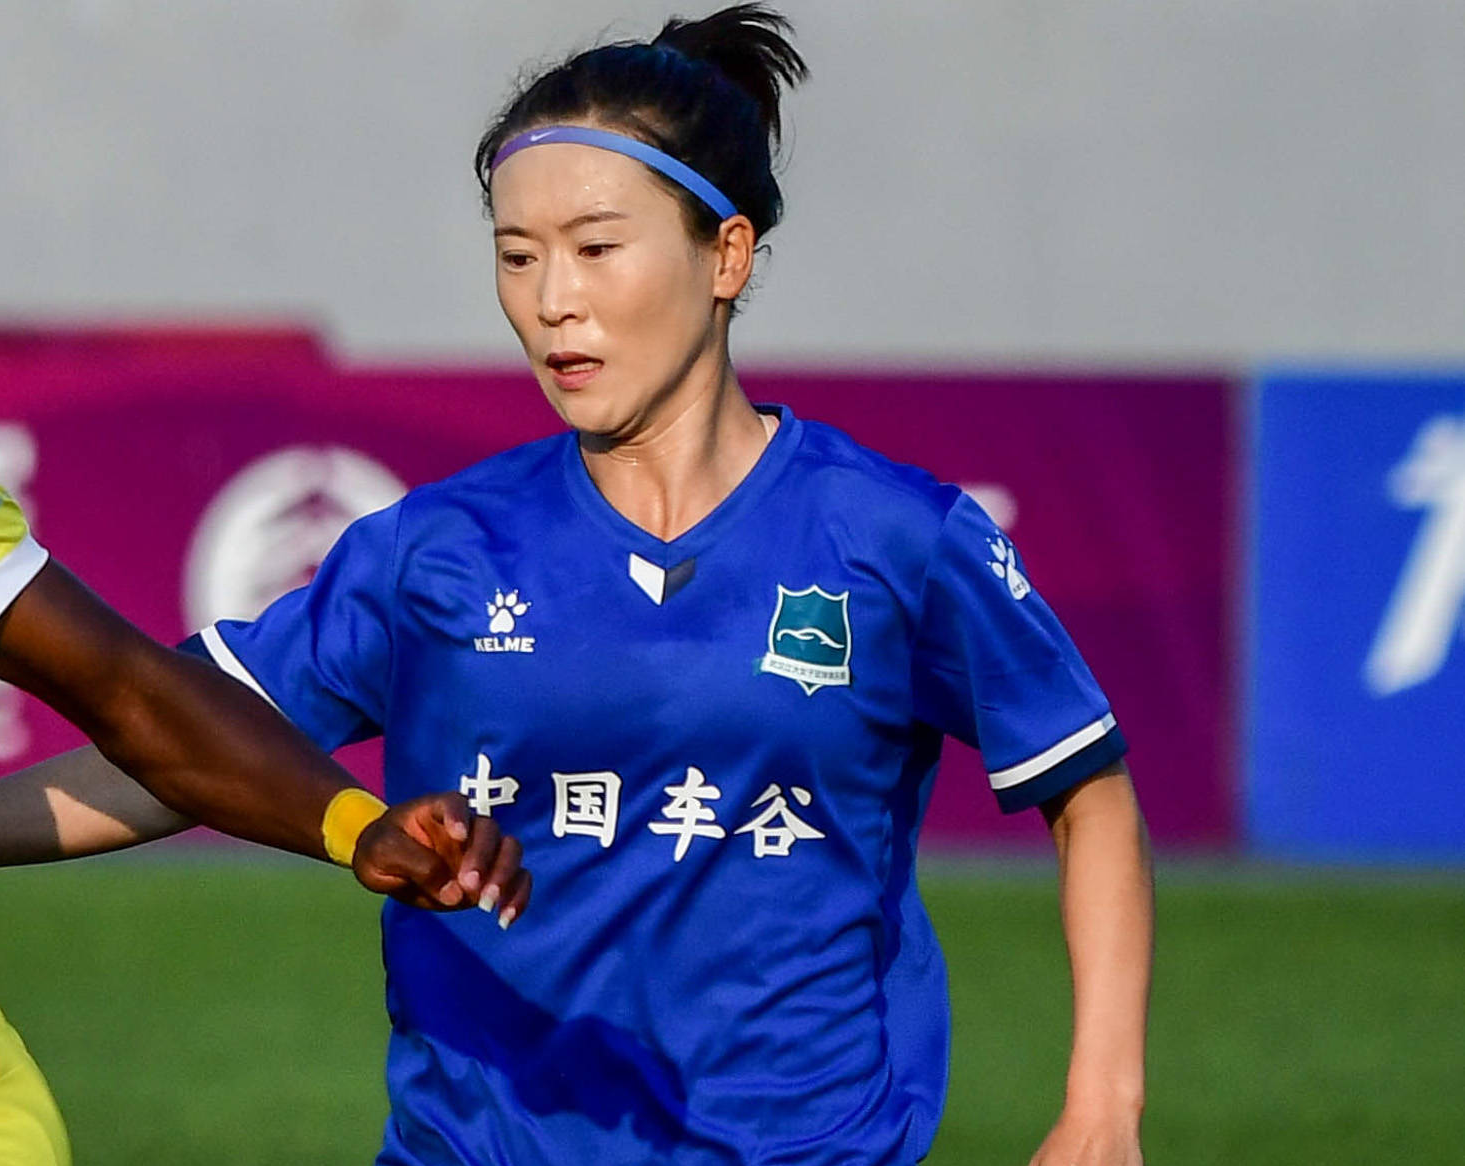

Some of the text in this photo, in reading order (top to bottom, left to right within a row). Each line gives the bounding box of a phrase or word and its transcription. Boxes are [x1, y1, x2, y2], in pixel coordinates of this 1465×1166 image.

[473, 636, 536, 653] KELME
[459, 753, 826, 863] 中国车谷
